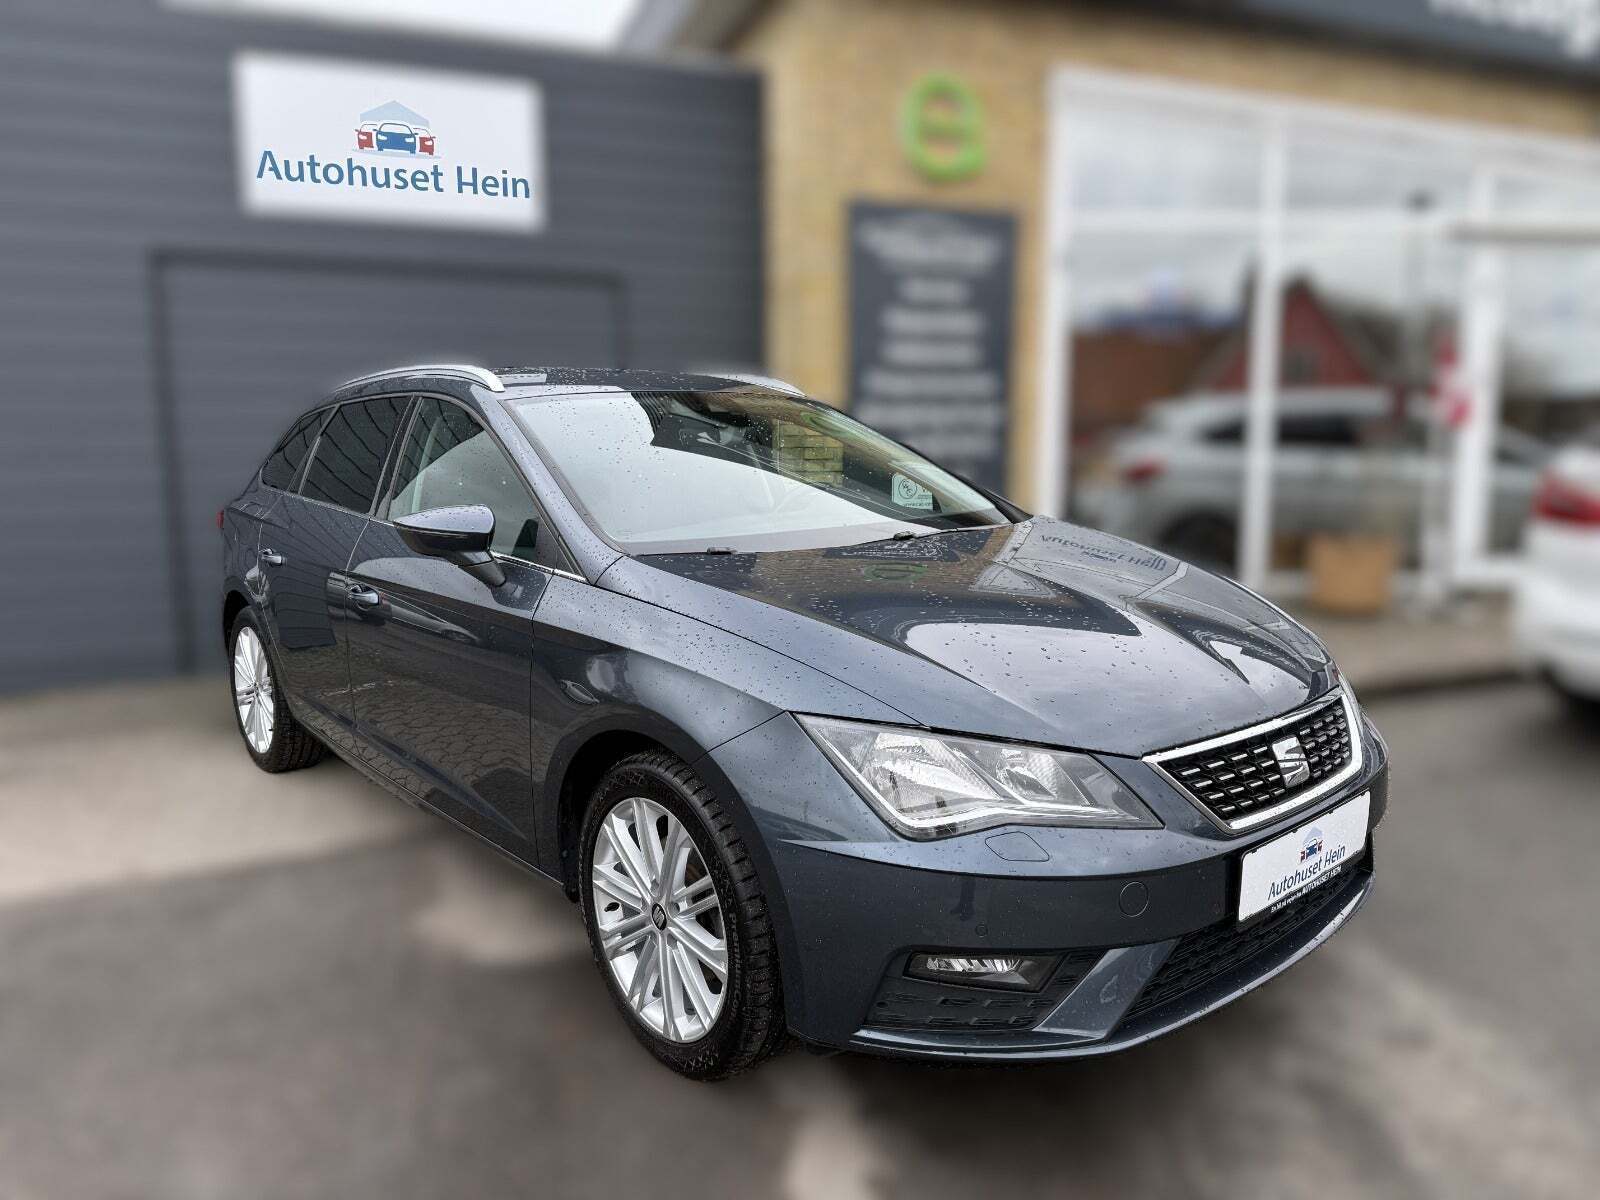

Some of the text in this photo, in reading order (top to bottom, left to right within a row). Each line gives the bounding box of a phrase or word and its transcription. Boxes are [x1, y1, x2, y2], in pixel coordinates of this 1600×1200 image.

[256, 150, 531, 199] Autohuset Hein
[1267, 860, 1322, 901] Autohuset
[1324, 844, 1346, 868] Hein
